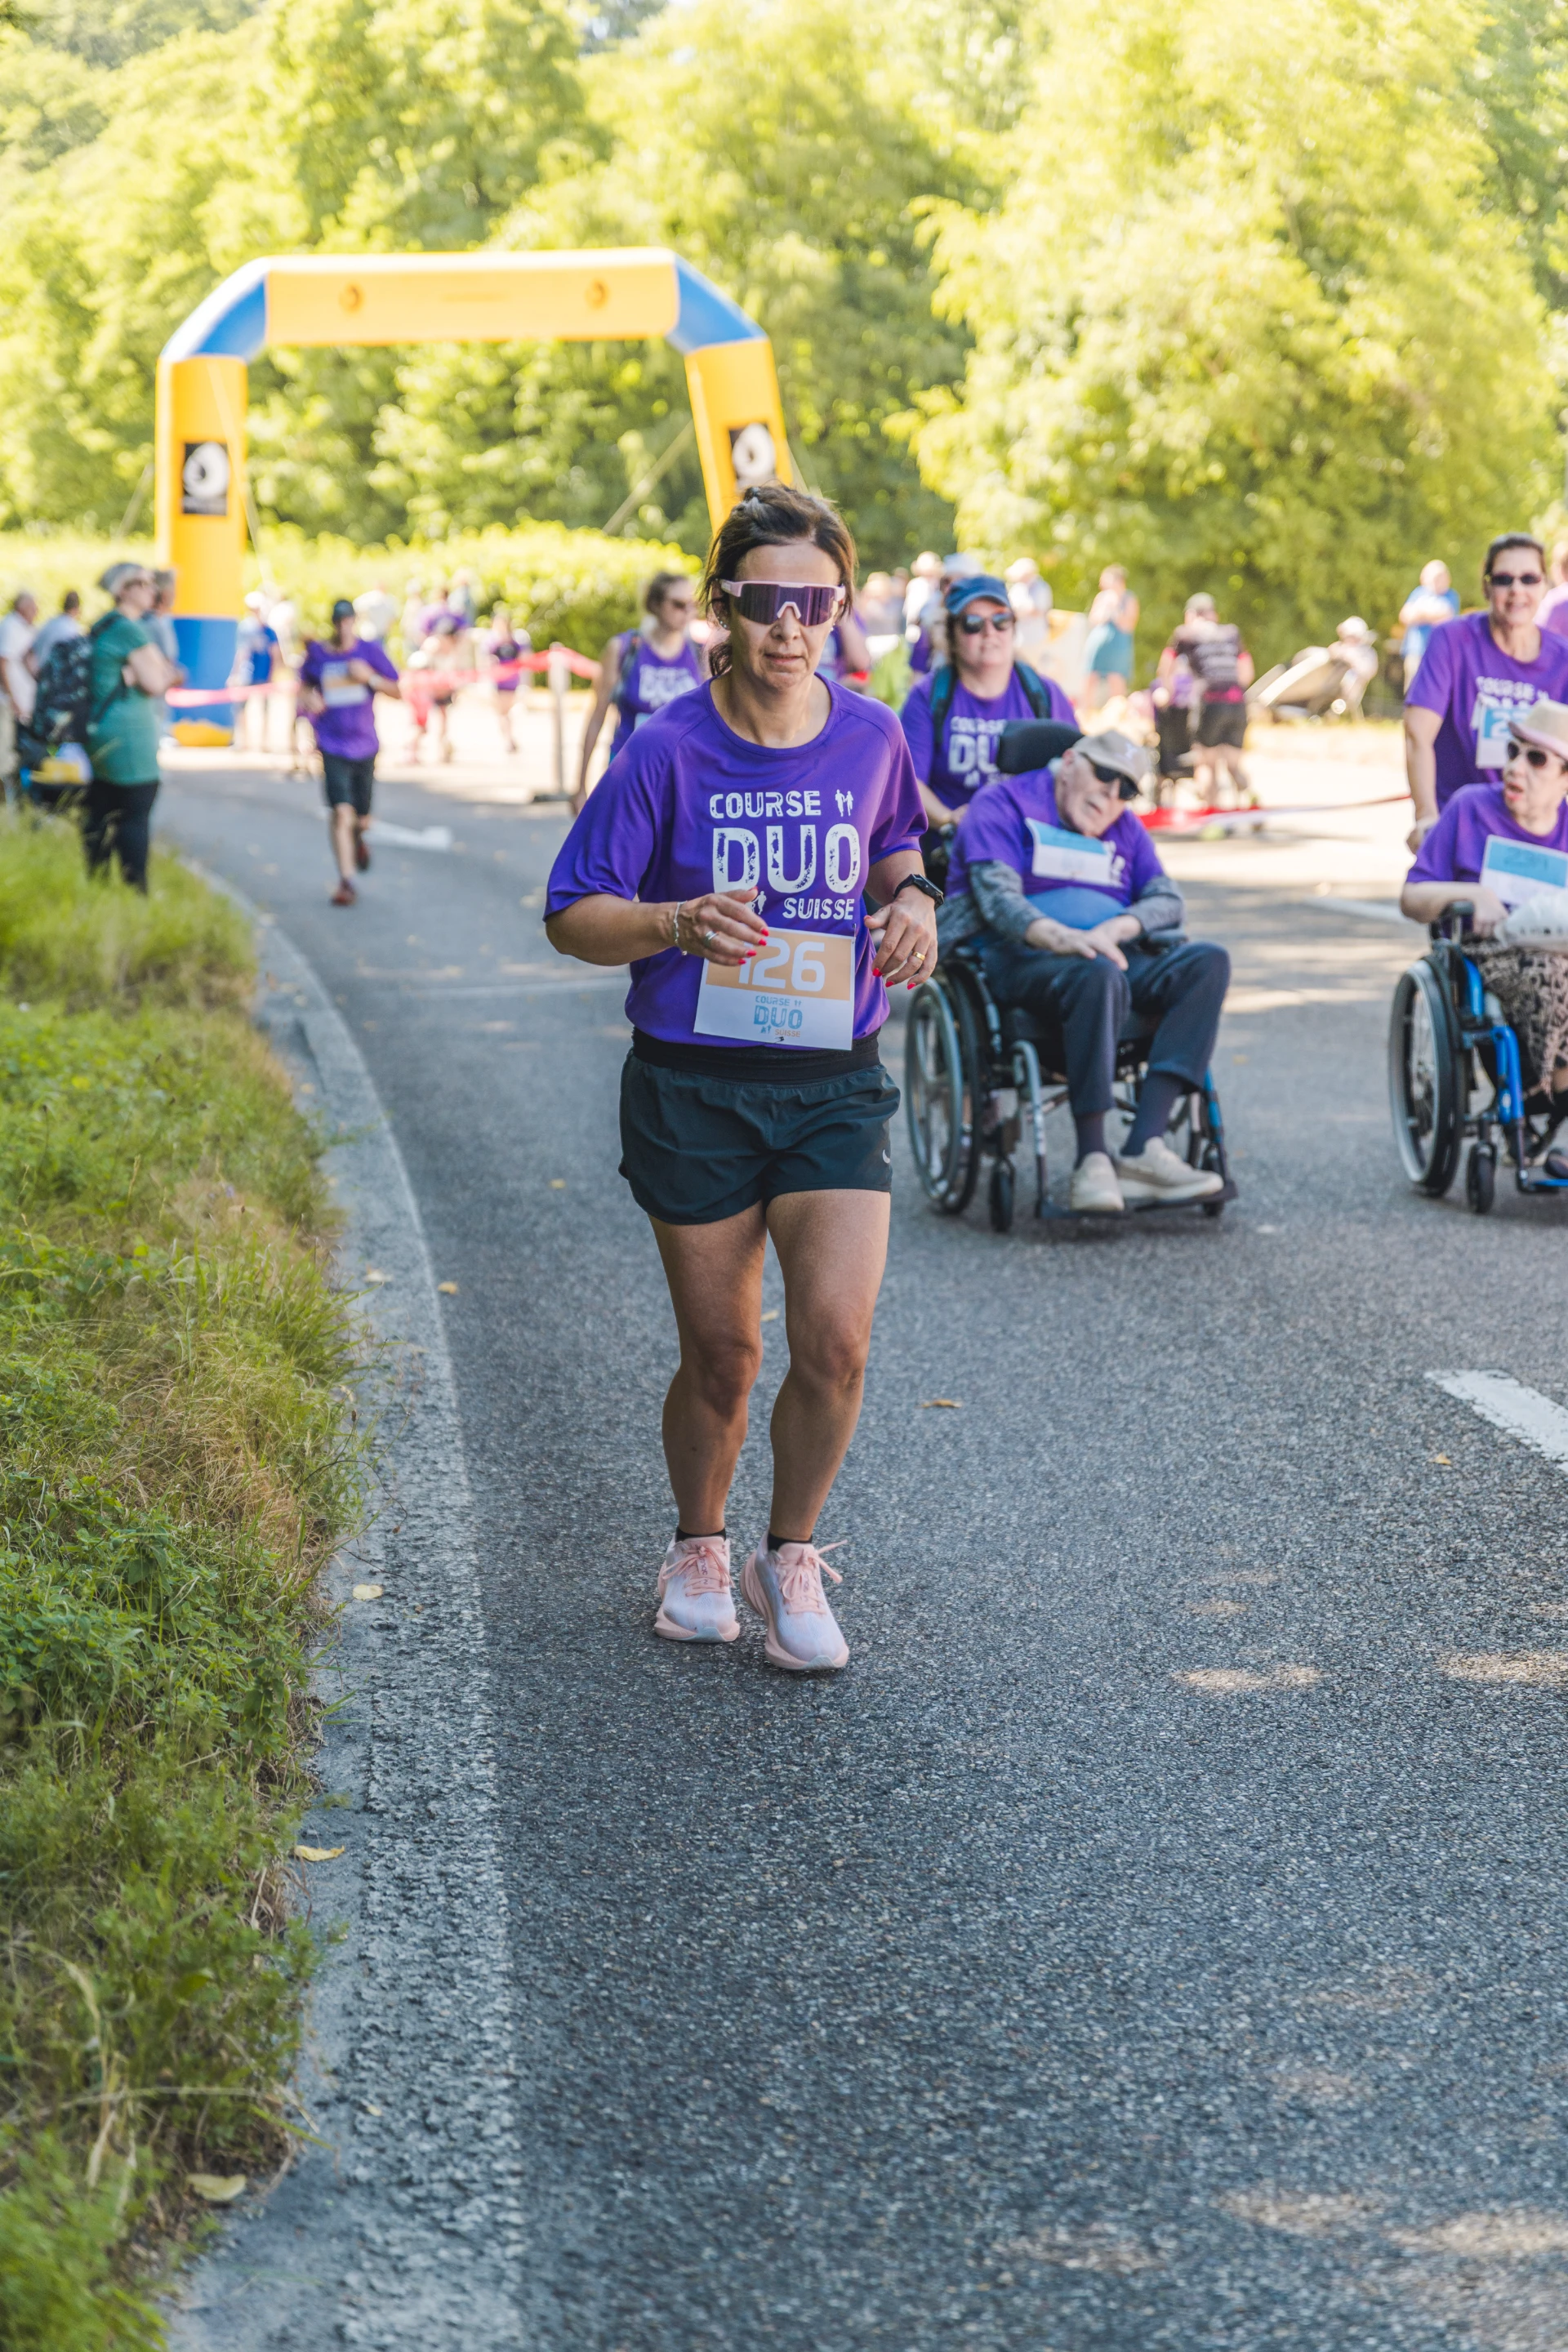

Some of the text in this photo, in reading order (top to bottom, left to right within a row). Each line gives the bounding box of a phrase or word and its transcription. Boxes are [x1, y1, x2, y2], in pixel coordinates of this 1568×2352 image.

[949, 733, 1000, 774] DU
[710, 791, 822, 819] COURSE
[712, 823, 861, 894] DUO
[782, 898, 855, 920] SUISSE
[738, 937, 826, 992] 126
[755, 996, 791, 1006] COURSE
[754, 1005, 803, 1029] DUO
[774, 1029, 800, 1037] SUISSE
